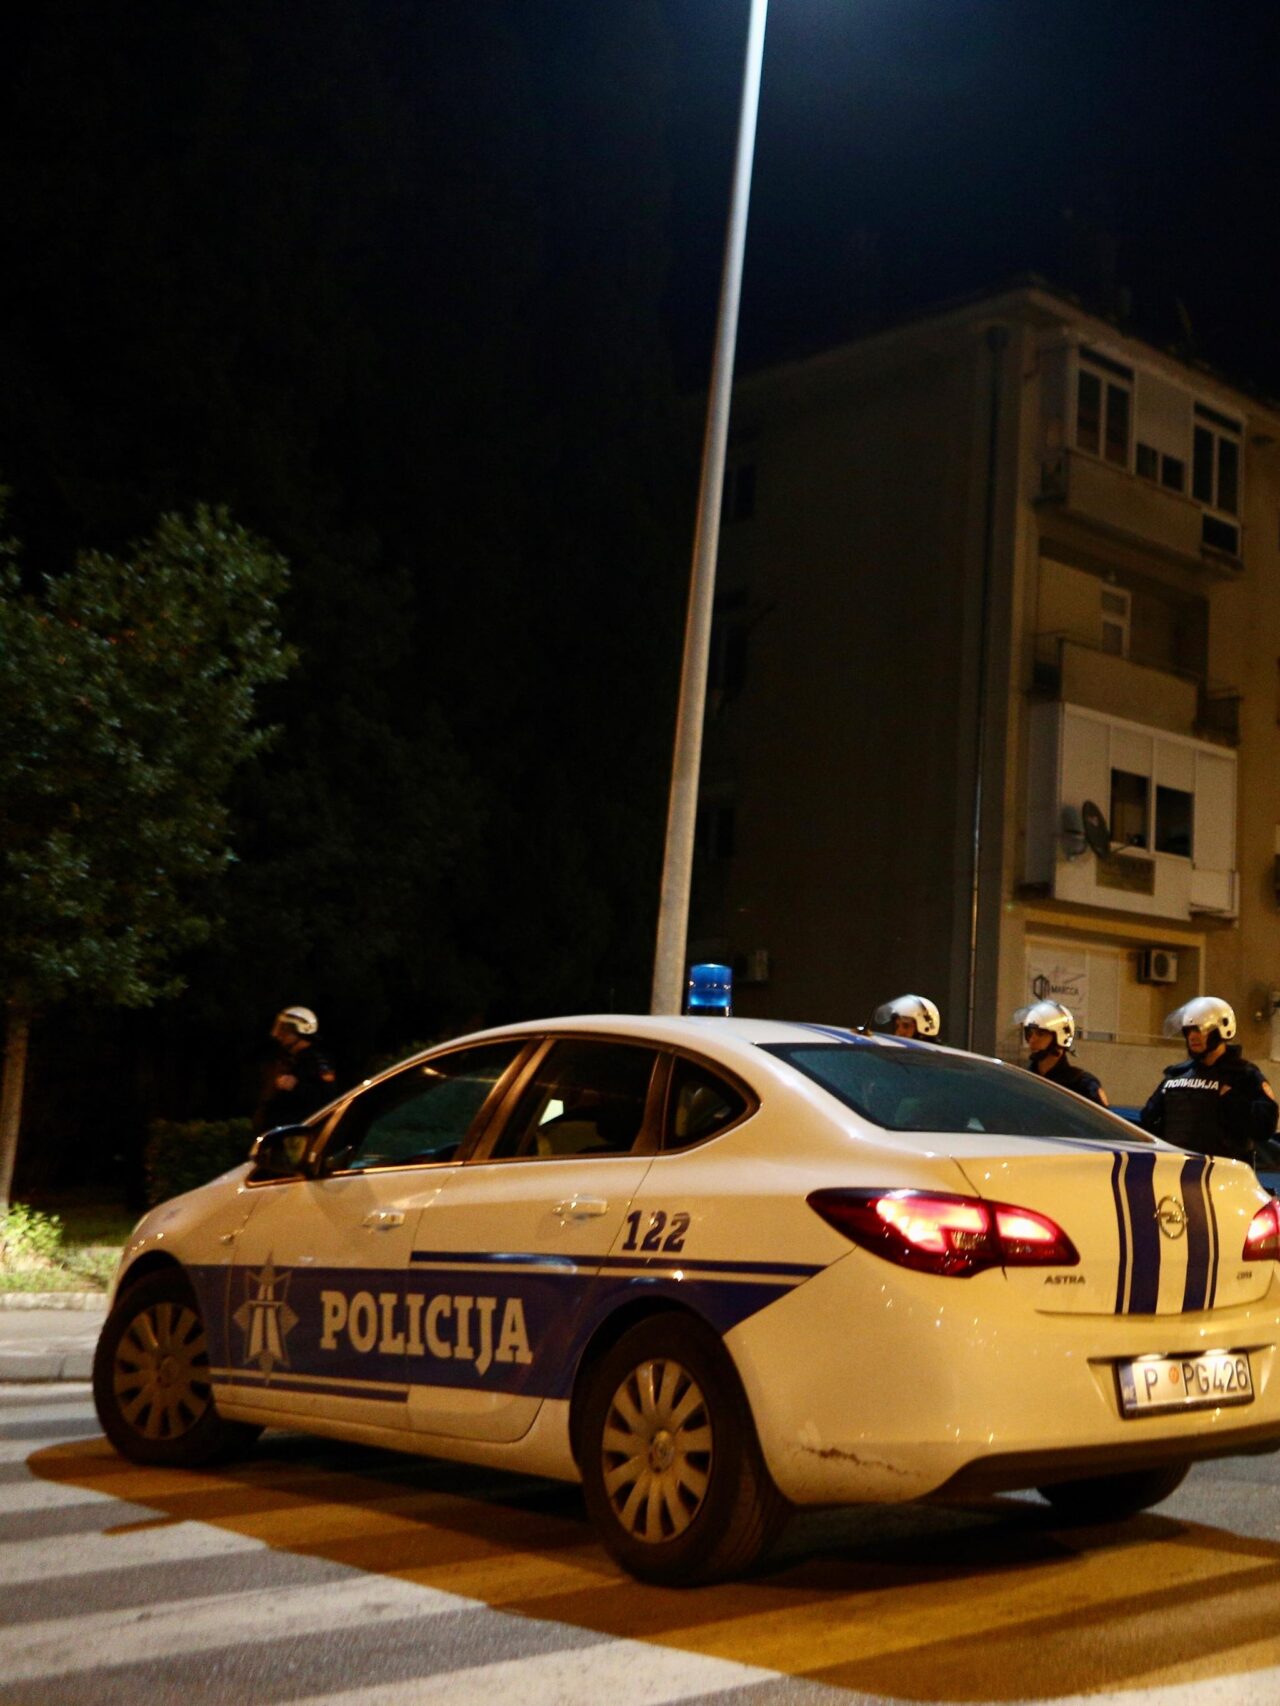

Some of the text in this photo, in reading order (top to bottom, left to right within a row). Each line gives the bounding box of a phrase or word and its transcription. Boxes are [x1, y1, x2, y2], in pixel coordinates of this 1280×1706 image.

[1164, 1078, 1220, 1091] ПОЛИЦИЈА
[622, 1209, 692, 1253] 122
[1044, 1274, 1086, 1285] ASTRA
[320, 1290, 533, 1377] POLICIJA
[1143, 1357, 1248, 1402] P PG426
